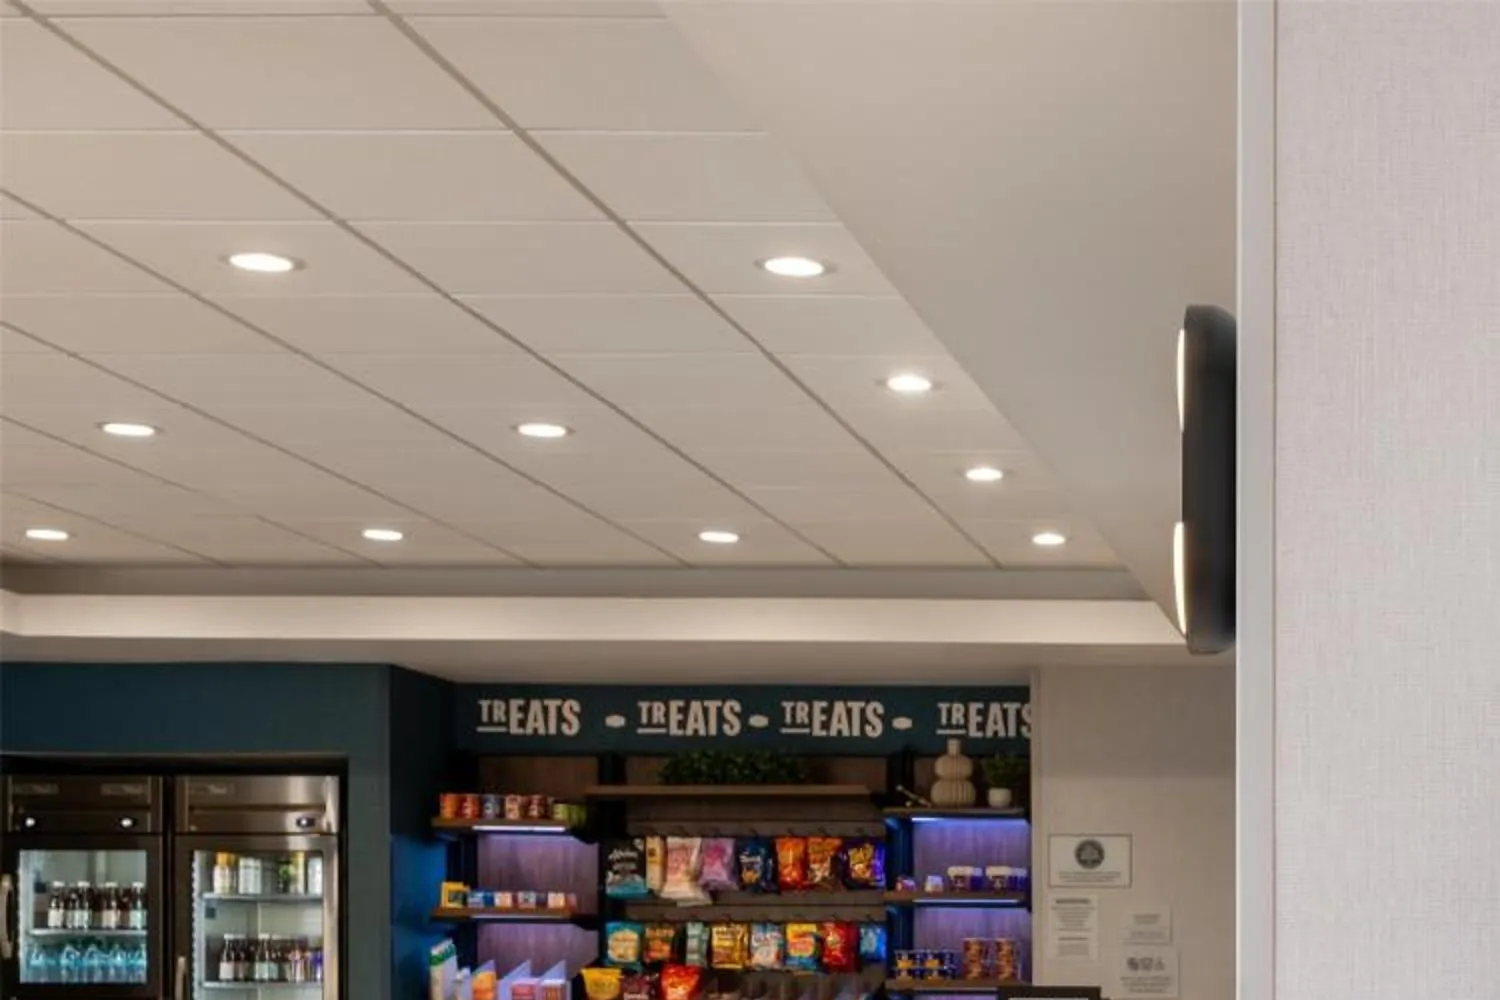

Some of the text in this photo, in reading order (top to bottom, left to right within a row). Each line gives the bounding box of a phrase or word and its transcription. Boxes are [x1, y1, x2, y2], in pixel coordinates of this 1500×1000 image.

[478, 699, 581, 736] TREATS
[637, 700, 742, 737] TREATS
[781, 700, 885, 738] TREATS
